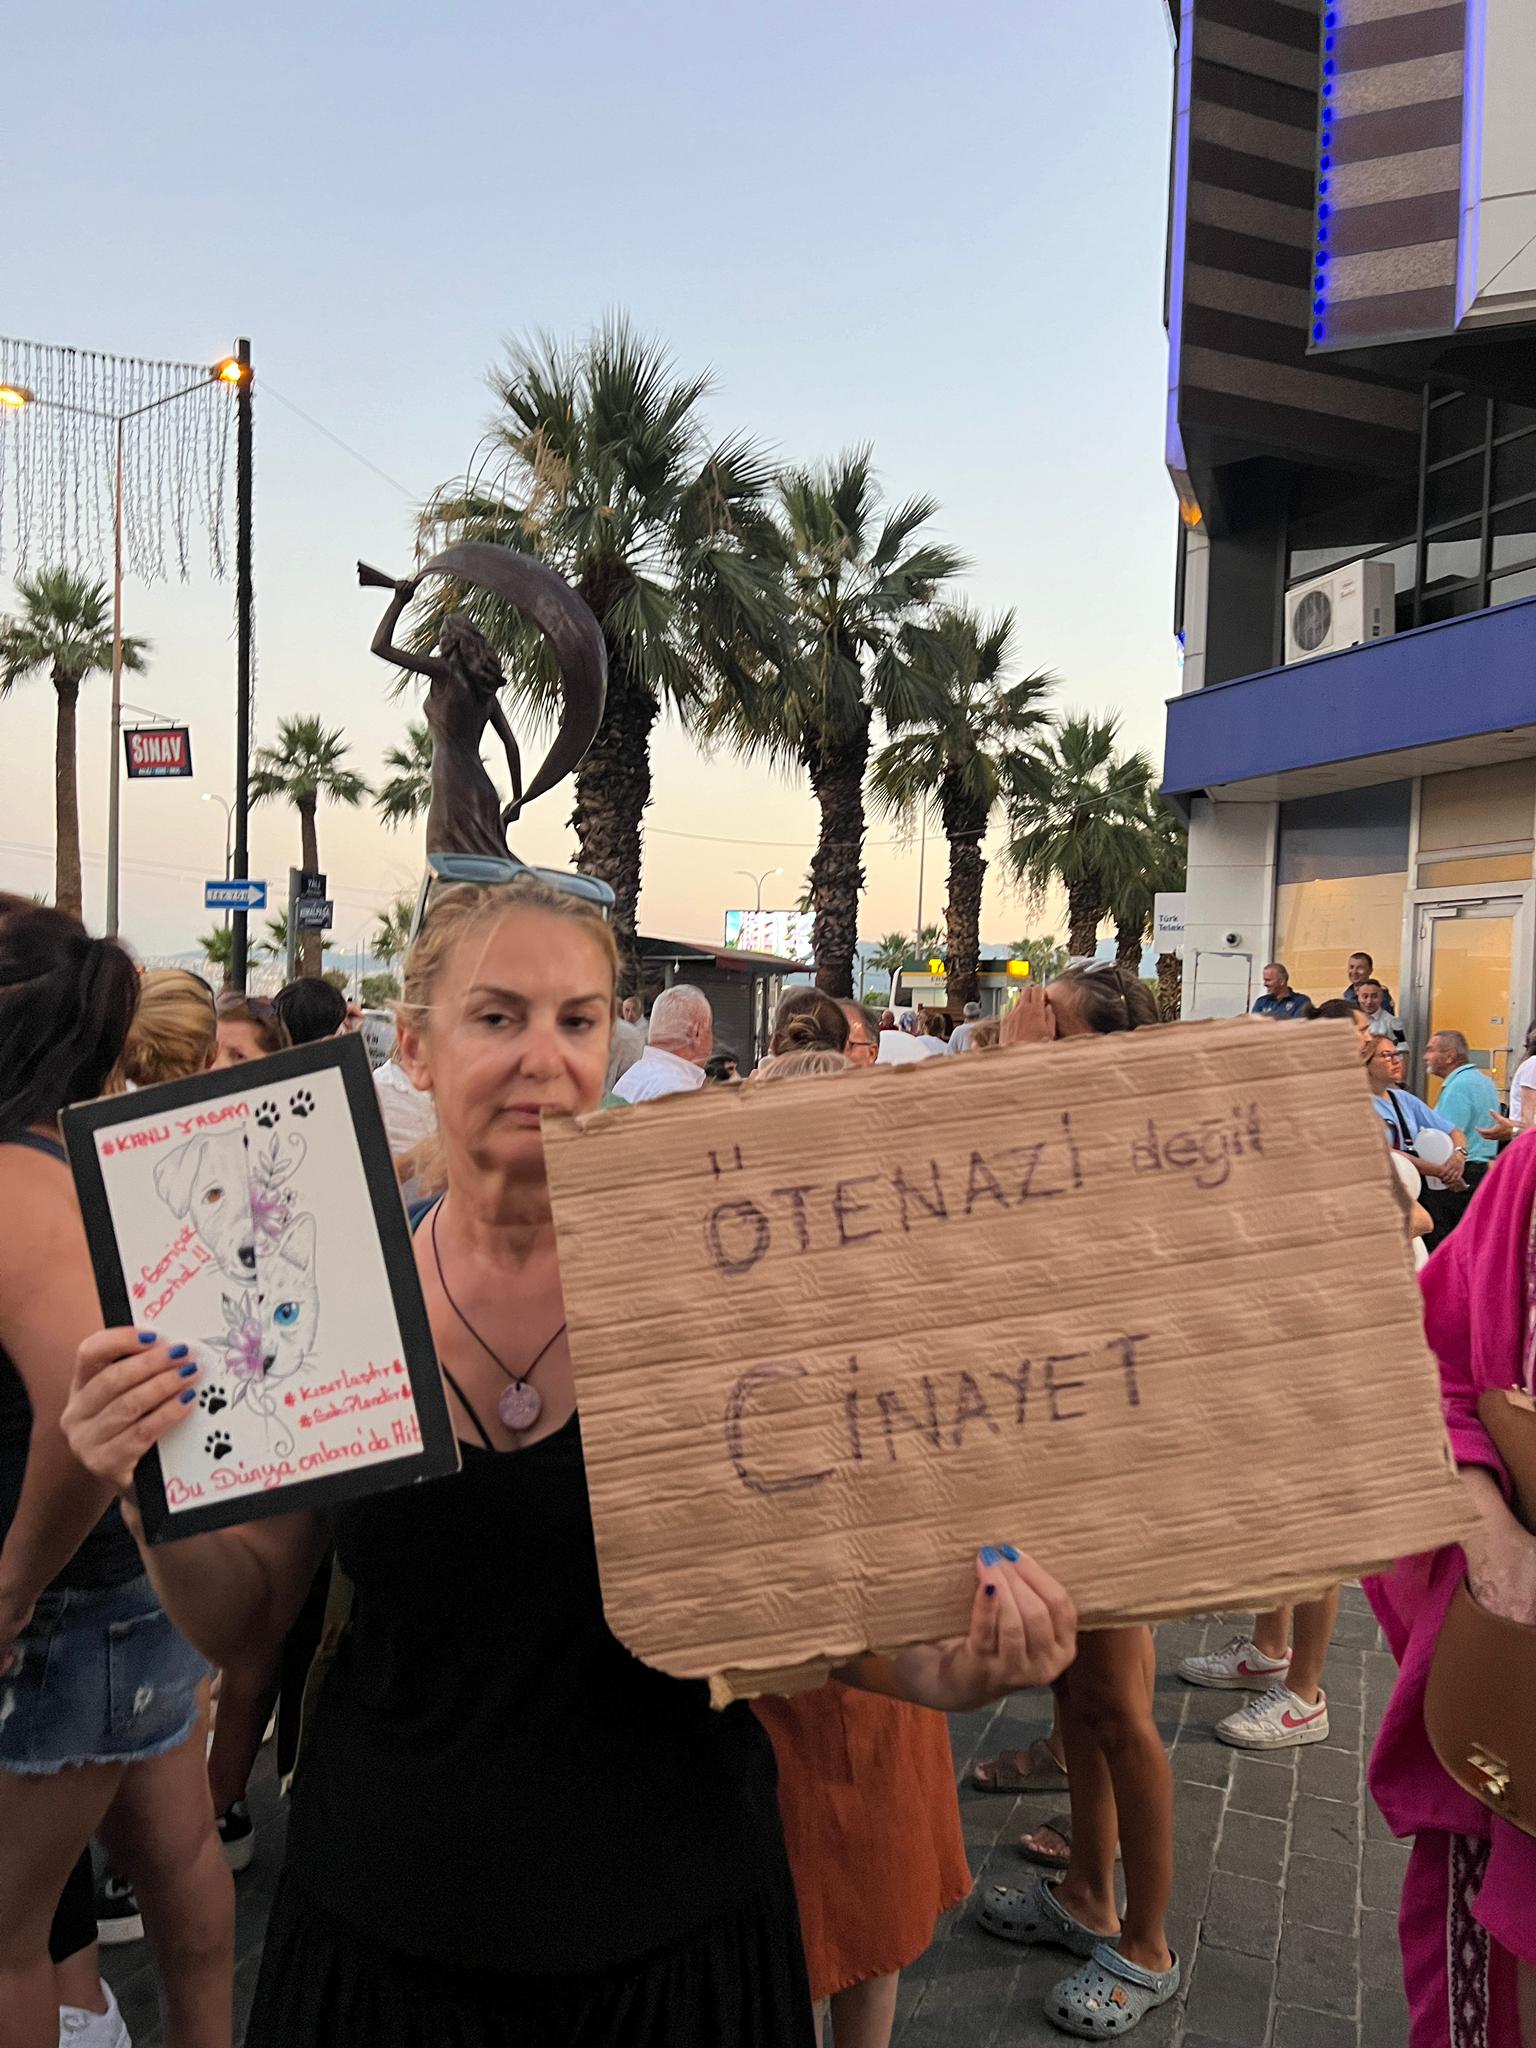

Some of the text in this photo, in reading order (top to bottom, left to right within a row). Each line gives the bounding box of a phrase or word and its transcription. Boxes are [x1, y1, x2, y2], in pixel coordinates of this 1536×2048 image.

[132, 734, 182, 763] SINAV
[1160, 914, 1178, 922] Türk
[704, 1104, 1264, 1275] ÖTENAZİ değil
[725, 1333, 1150, 1493] CİNAYET
[165, 1477, 205, 1505] Bu
[211, 1461, 296, 1490] Dünya
